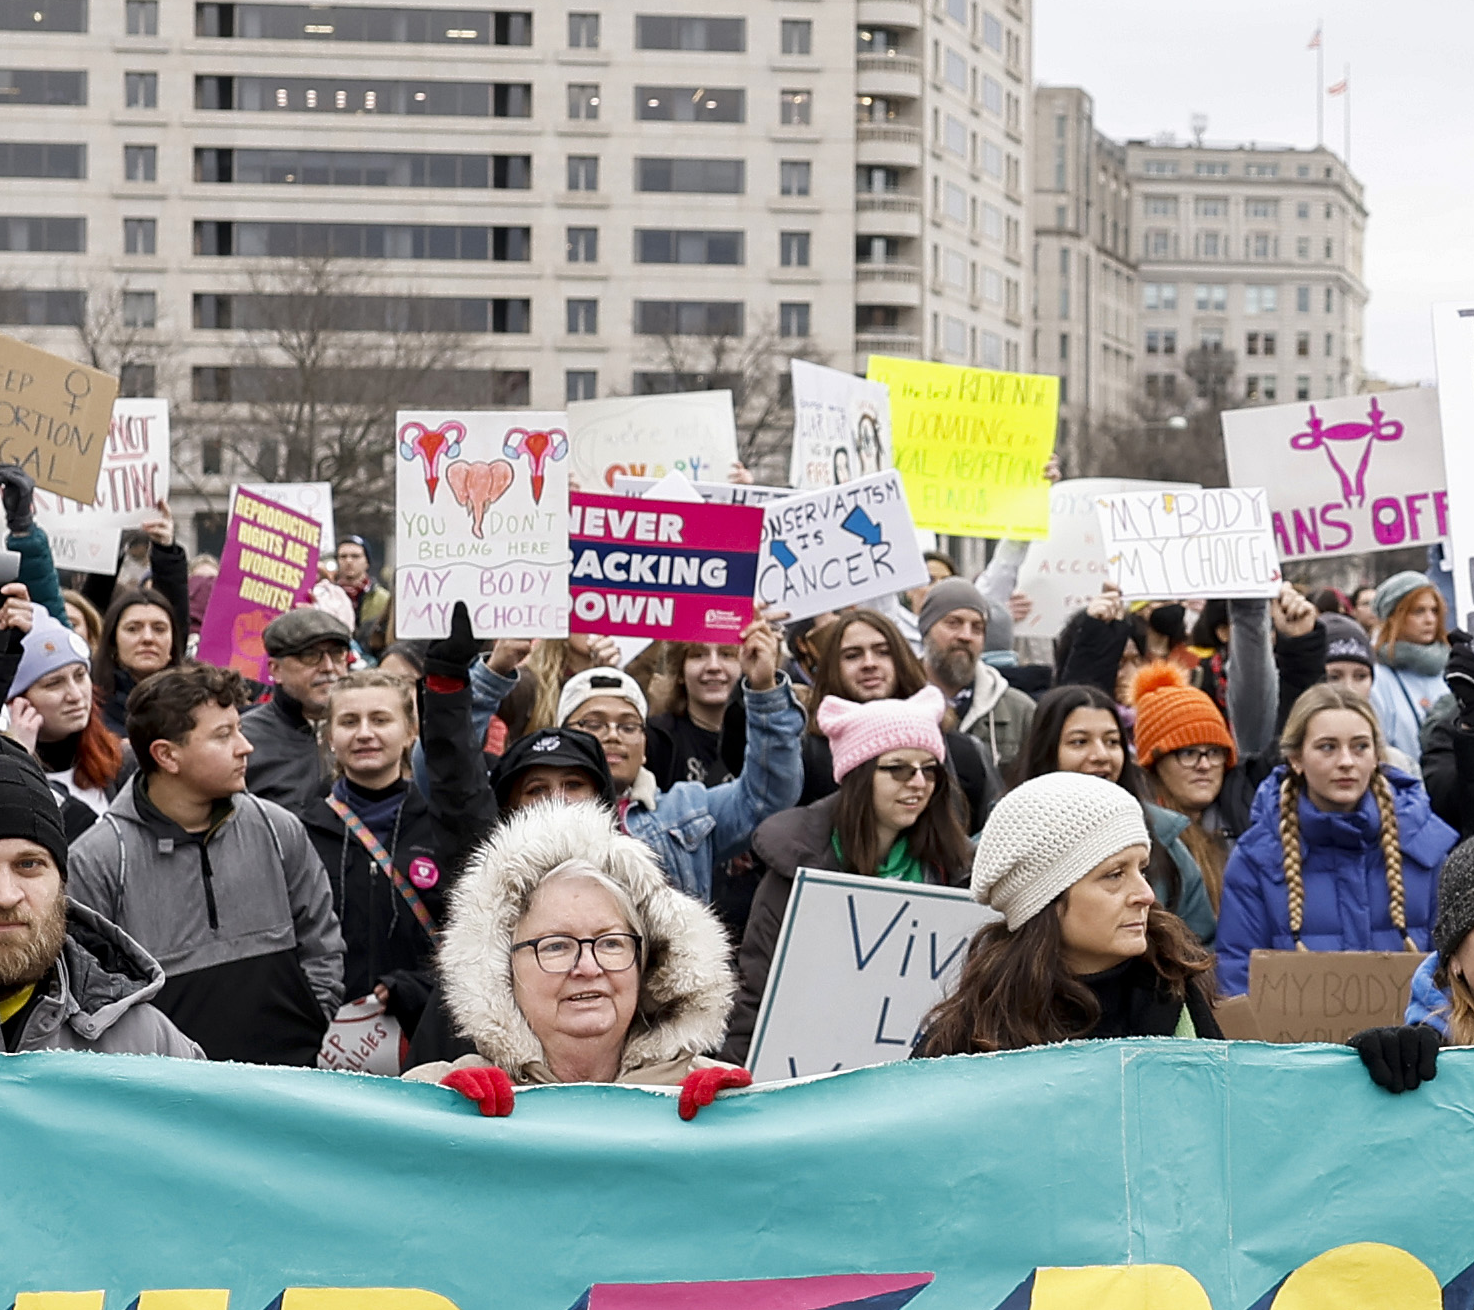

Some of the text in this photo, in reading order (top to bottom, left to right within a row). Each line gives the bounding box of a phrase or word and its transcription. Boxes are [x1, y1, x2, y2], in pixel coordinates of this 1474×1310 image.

[402, 510, 557, 538] YOU DON'T
[1111, 489, 1264, 539] MY BODY
[1272, 502, 1353, 556] ANS
[418, 541, 551, 560] BELONG HERE
[568, 550, 728, 588] ACKING
[1116, 538, 1176, 595] MY
[402, 570, 552, 600] MY BODY
[759, 541, 895, 605] CANCER
[402, 602, 568, 634] MY CHOICE
[568, 590, 675, 627] OWN
[847, 892, 970, 980] Viv
[1256, 970, 1414, 1019] MY BODY
